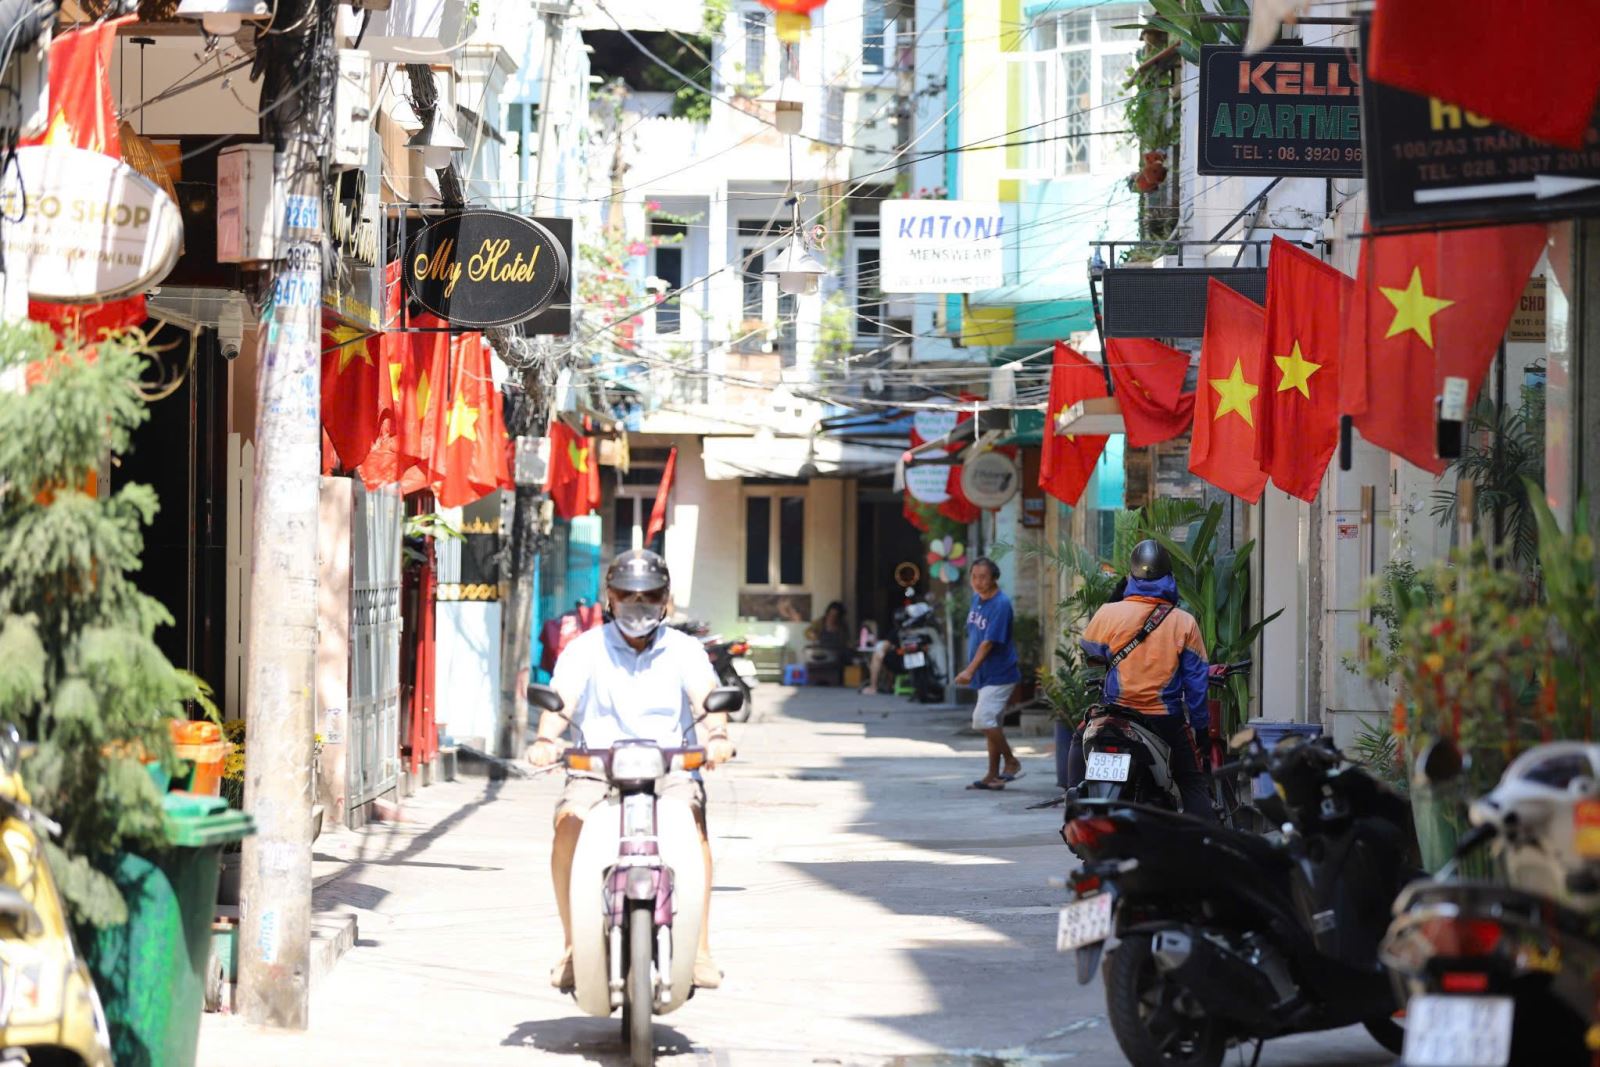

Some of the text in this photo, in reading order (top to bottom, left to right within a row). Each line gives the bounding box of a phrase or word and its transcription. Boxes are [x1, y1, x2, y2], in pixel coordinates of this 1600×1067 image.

[1304, 146, 1341, 162] 3920
[72, 199, 150, 229] SHOP
[898, 215, 1005, 239] KATONI
[413, 238, 541, 298] My Hotel
